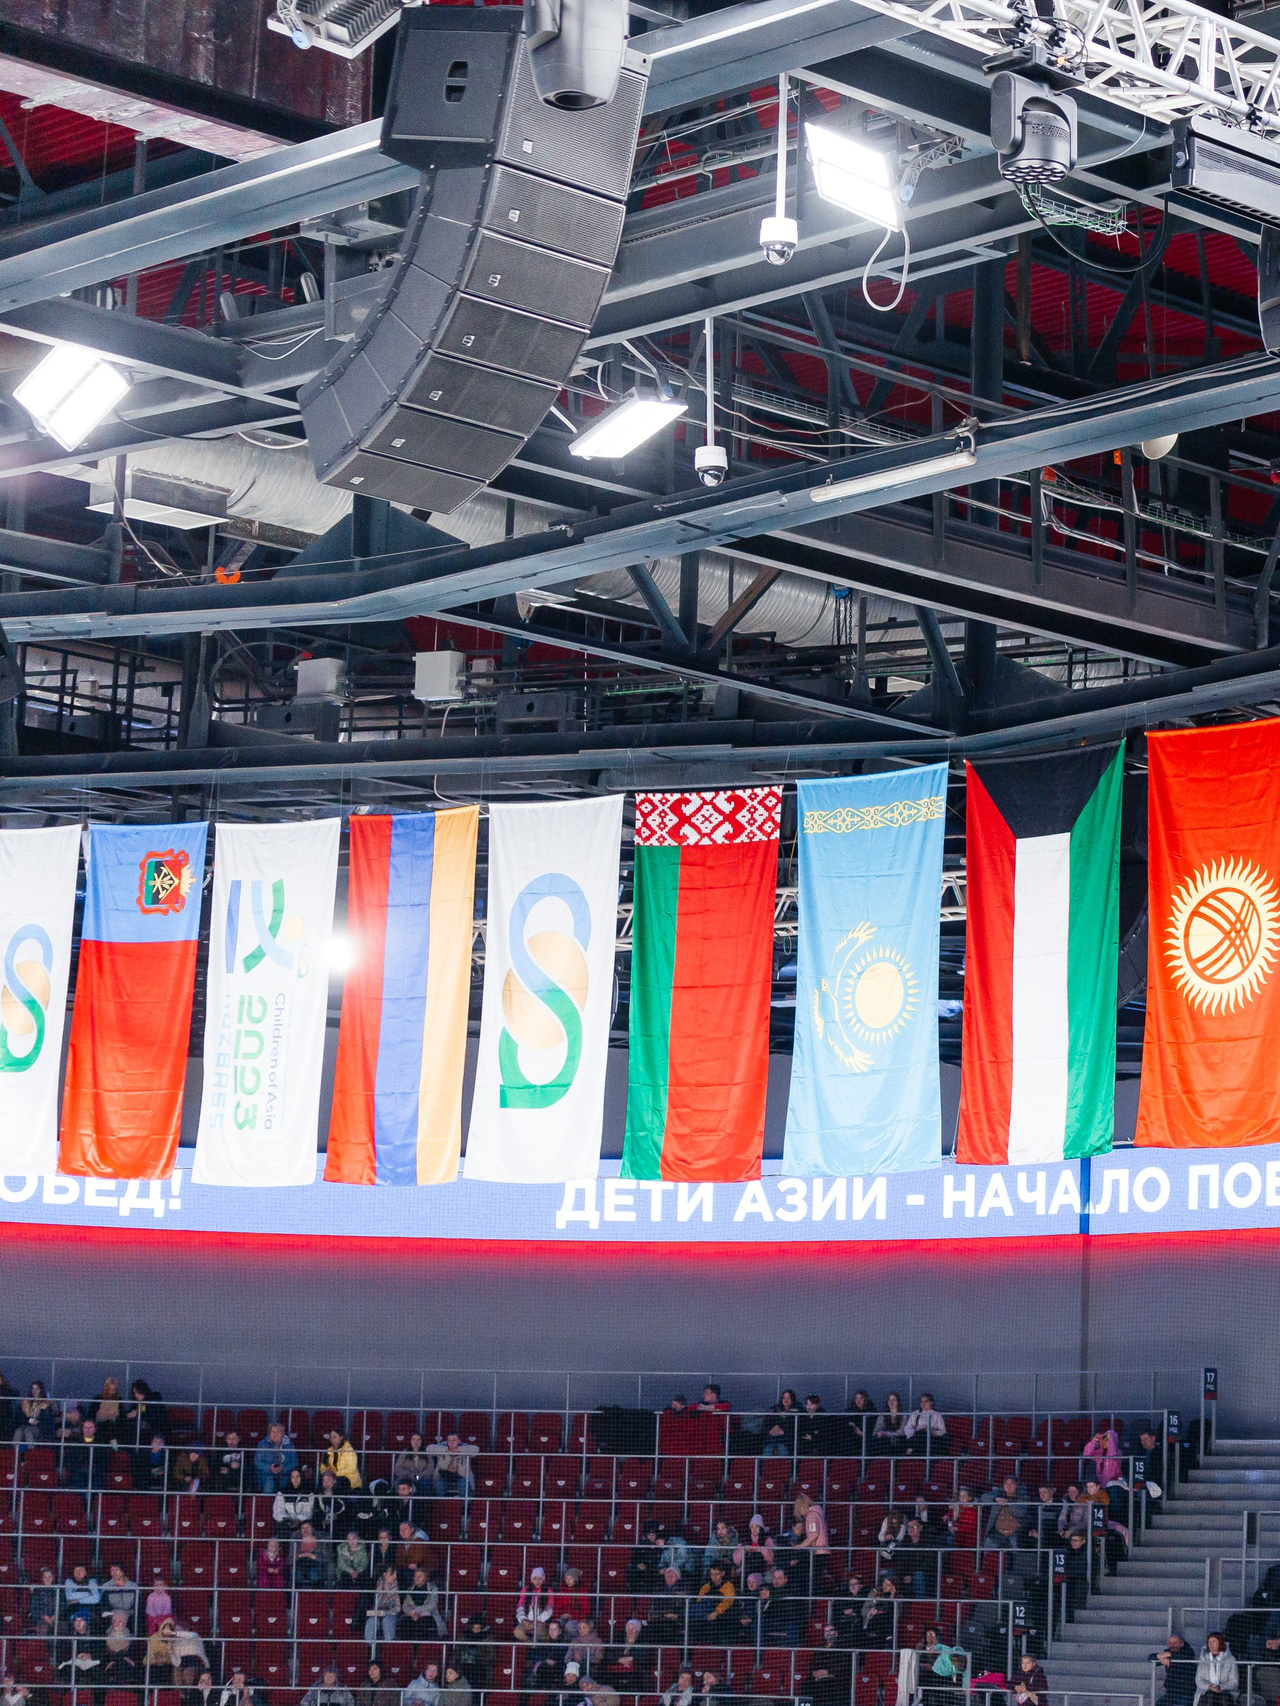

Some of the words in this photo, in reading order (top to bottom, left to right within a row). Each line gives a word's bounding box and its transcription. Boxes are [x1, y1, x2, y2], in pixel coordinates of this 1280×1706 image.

[269, 993, 286, 1069] Children
[233, 994, 268, 1131] 2023
[268, 1072, 278, 1089] of
[264, 1091, 277, 1131] Asia
[556, 1177, 713, 1230] ДЕТИ
[734, 1176, 887, 1223] АЗИИ
[906, 1194, 925, 1206] -
[943, 1164, 1170, 1219] НАЧАЛО
[1206, 1372, 1215, 1383] 17
[1169, 1415, 1178, 1425] 16
[1135, 1461, 1144, 1472] 15
[1093, 1508, 1103, 1519] 14
[1055, 1554, 1065, 1565] 13
[1015, 1606, 1025, 1617] 12
